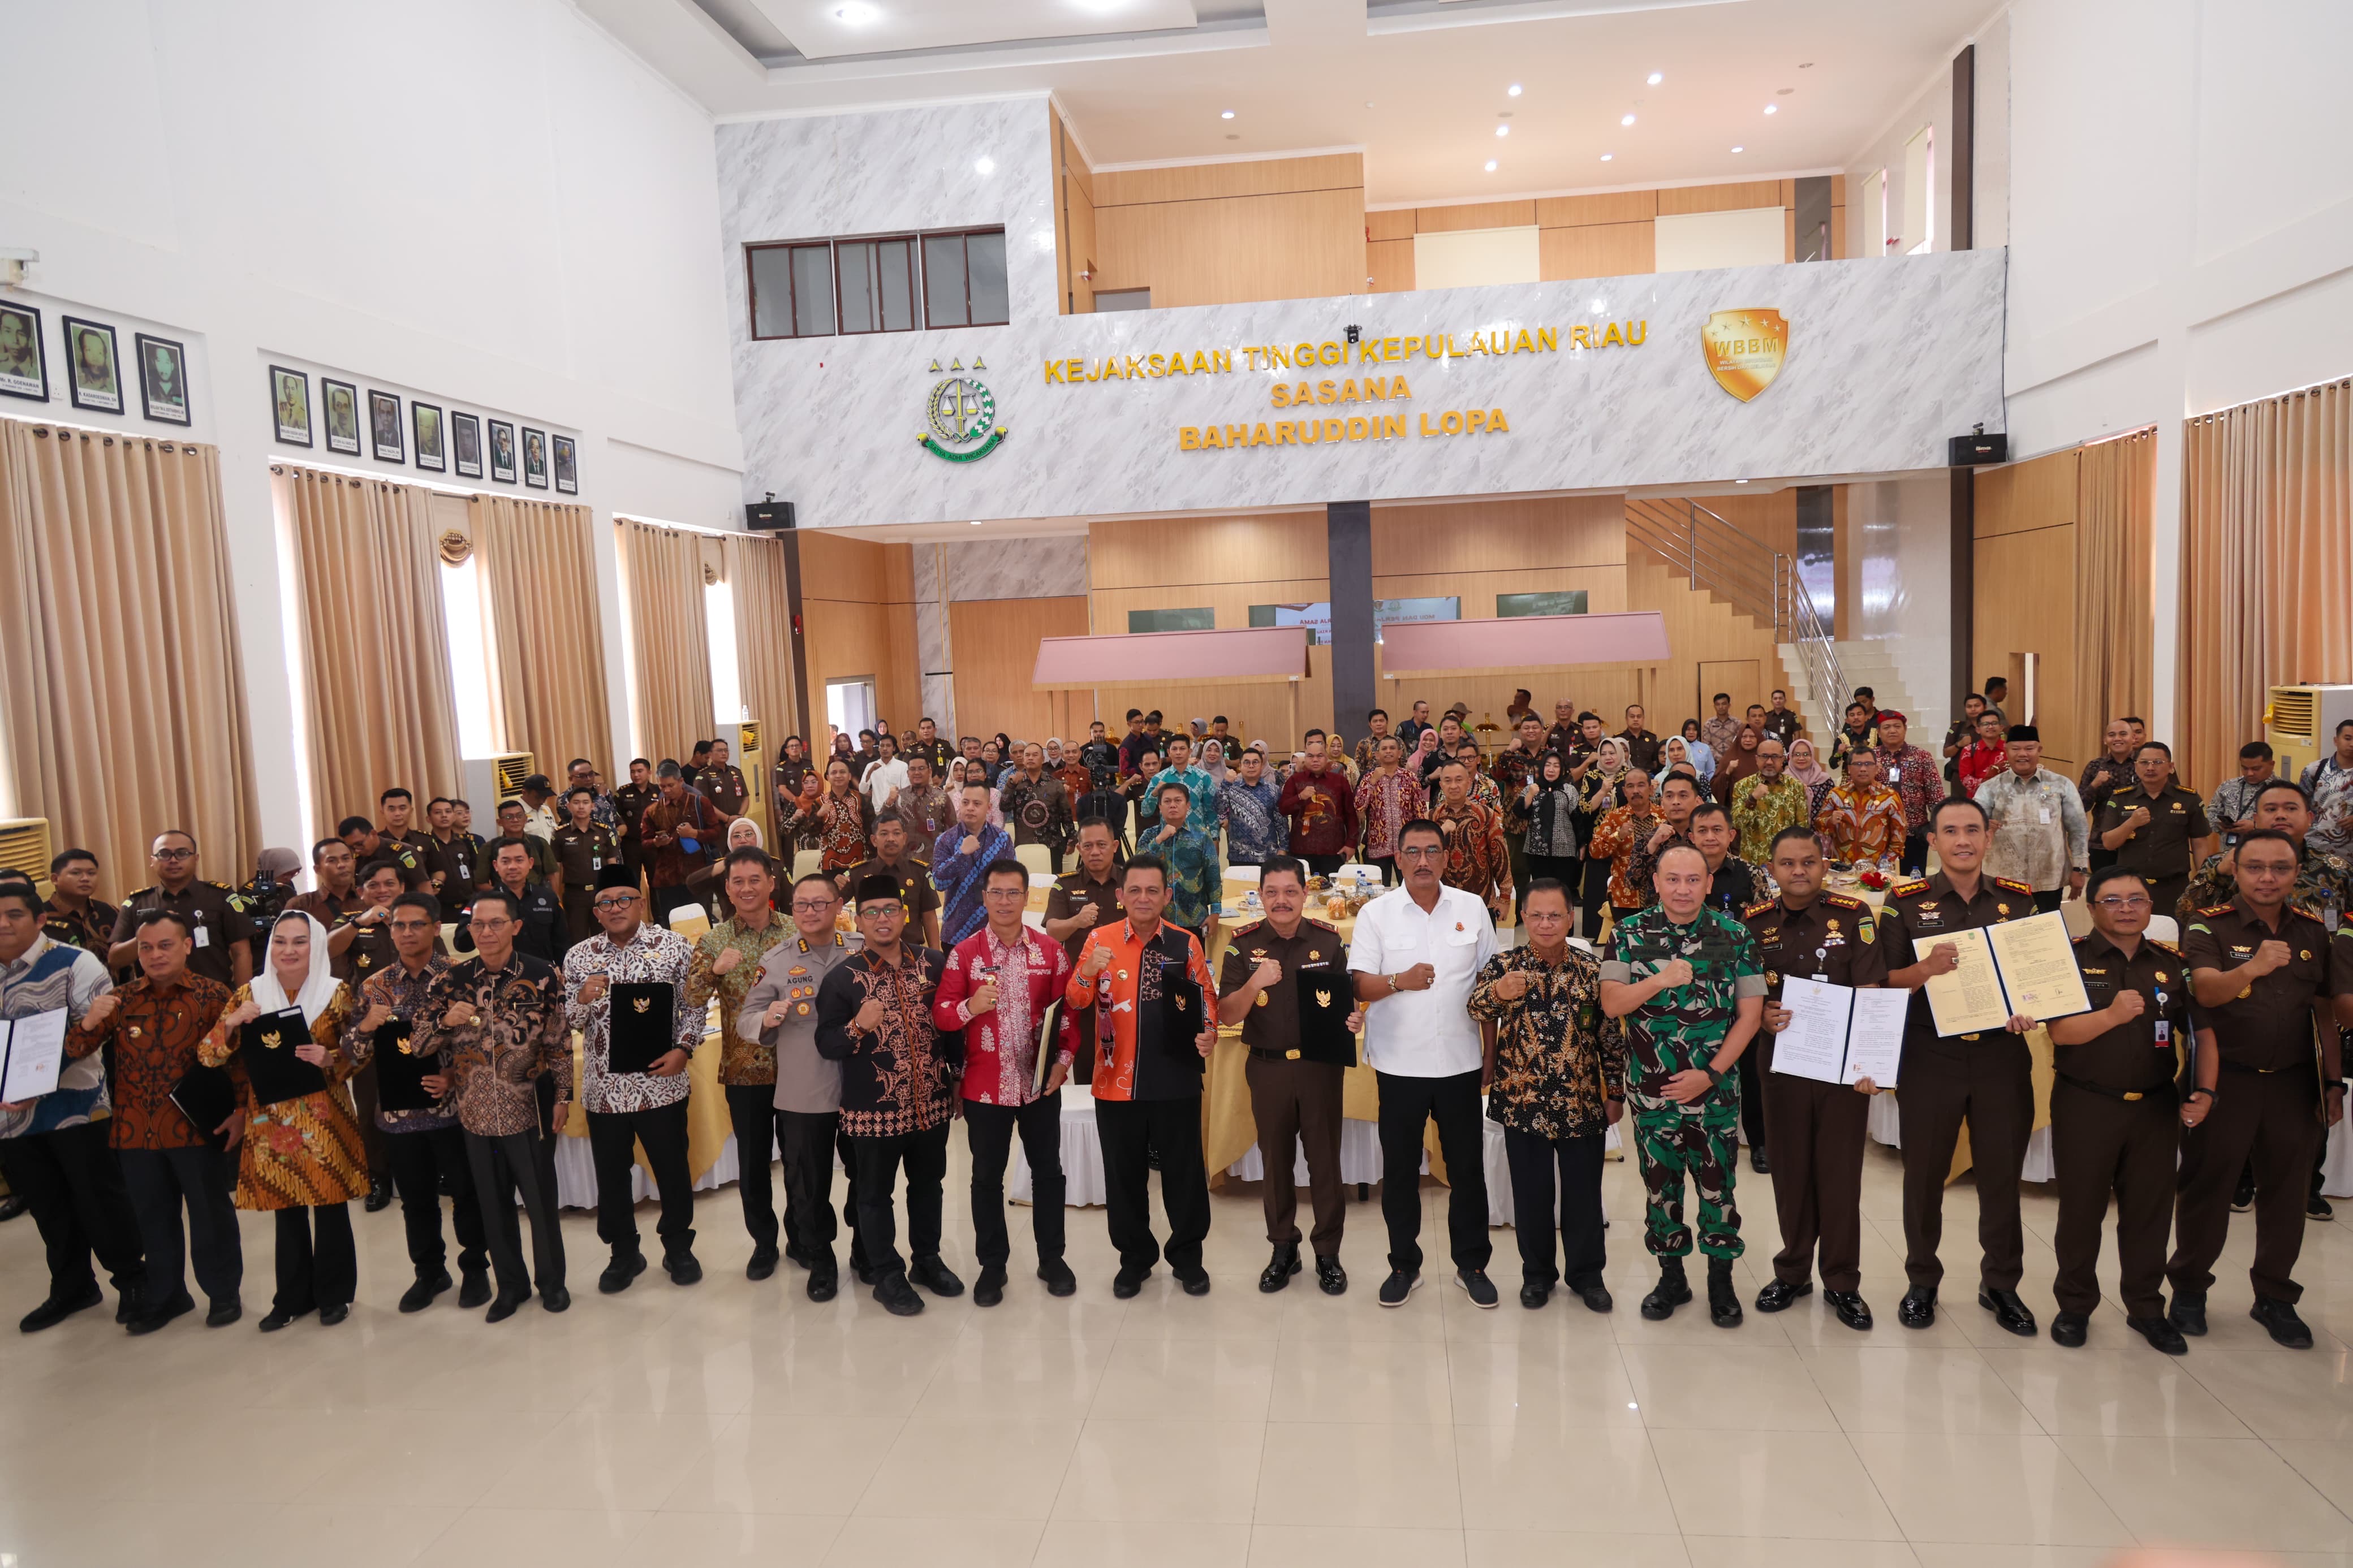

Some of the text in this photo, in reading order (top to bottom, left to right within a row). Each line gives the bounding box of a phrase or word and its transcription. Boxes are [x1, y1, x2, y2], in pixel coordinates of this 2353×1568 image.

[1045, 320, 1647, 384] KEJAKSAAN TINGGI KEPULAUAN RIAU
[1714, 337, 1778, 357] WBBM
[1270, 375, 1412, 408] SASANA
[1179, 408, 1509, 451] BAHARUDDIN LOPA
[929, 443, 946, 457] SATYA
[964, 439, 996, 460] WICAKSANA
[787, 975, 813, 984] AGUNG
